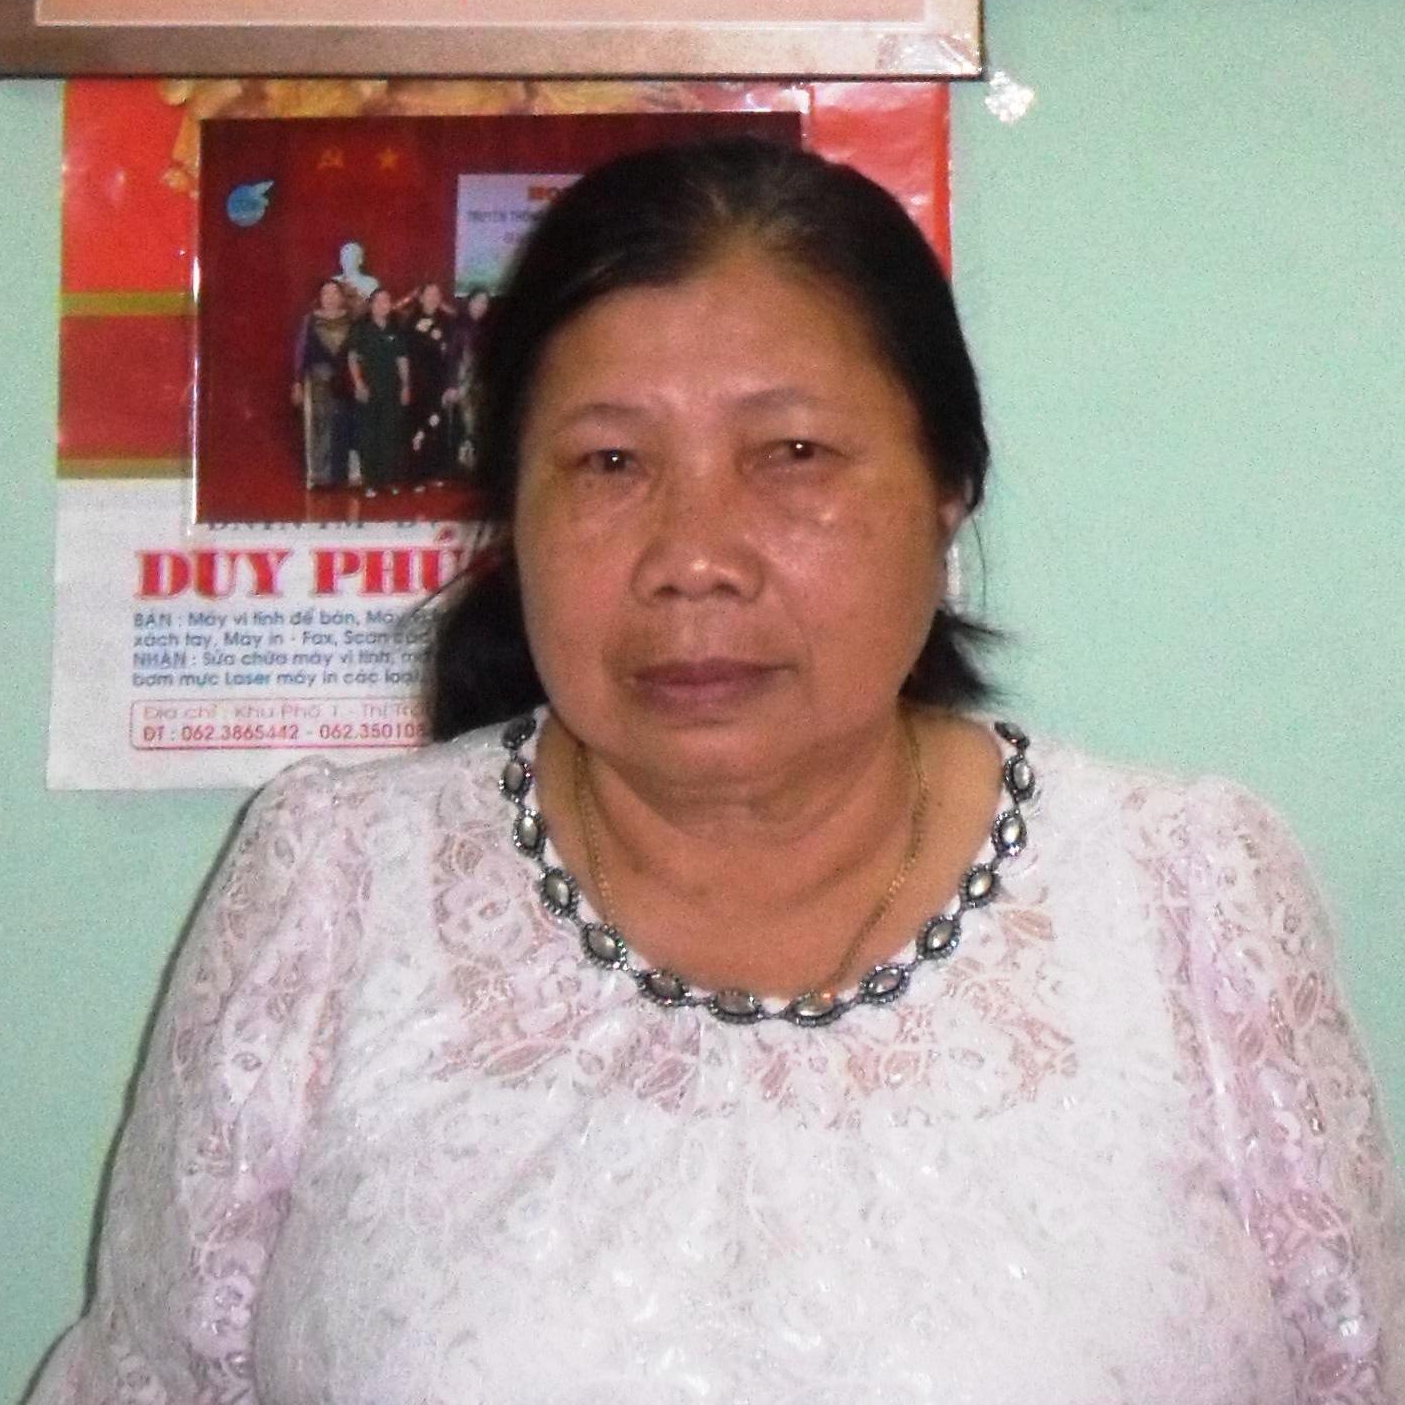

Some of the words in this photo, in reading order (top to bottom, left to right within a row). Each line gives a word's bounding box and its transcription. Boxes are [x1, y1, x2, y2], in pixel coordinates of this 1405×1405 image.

[135, 549, 291, 600] DUY
[188, 610, 228, 629] Máy
[226, 671, 271, 686] Laser
